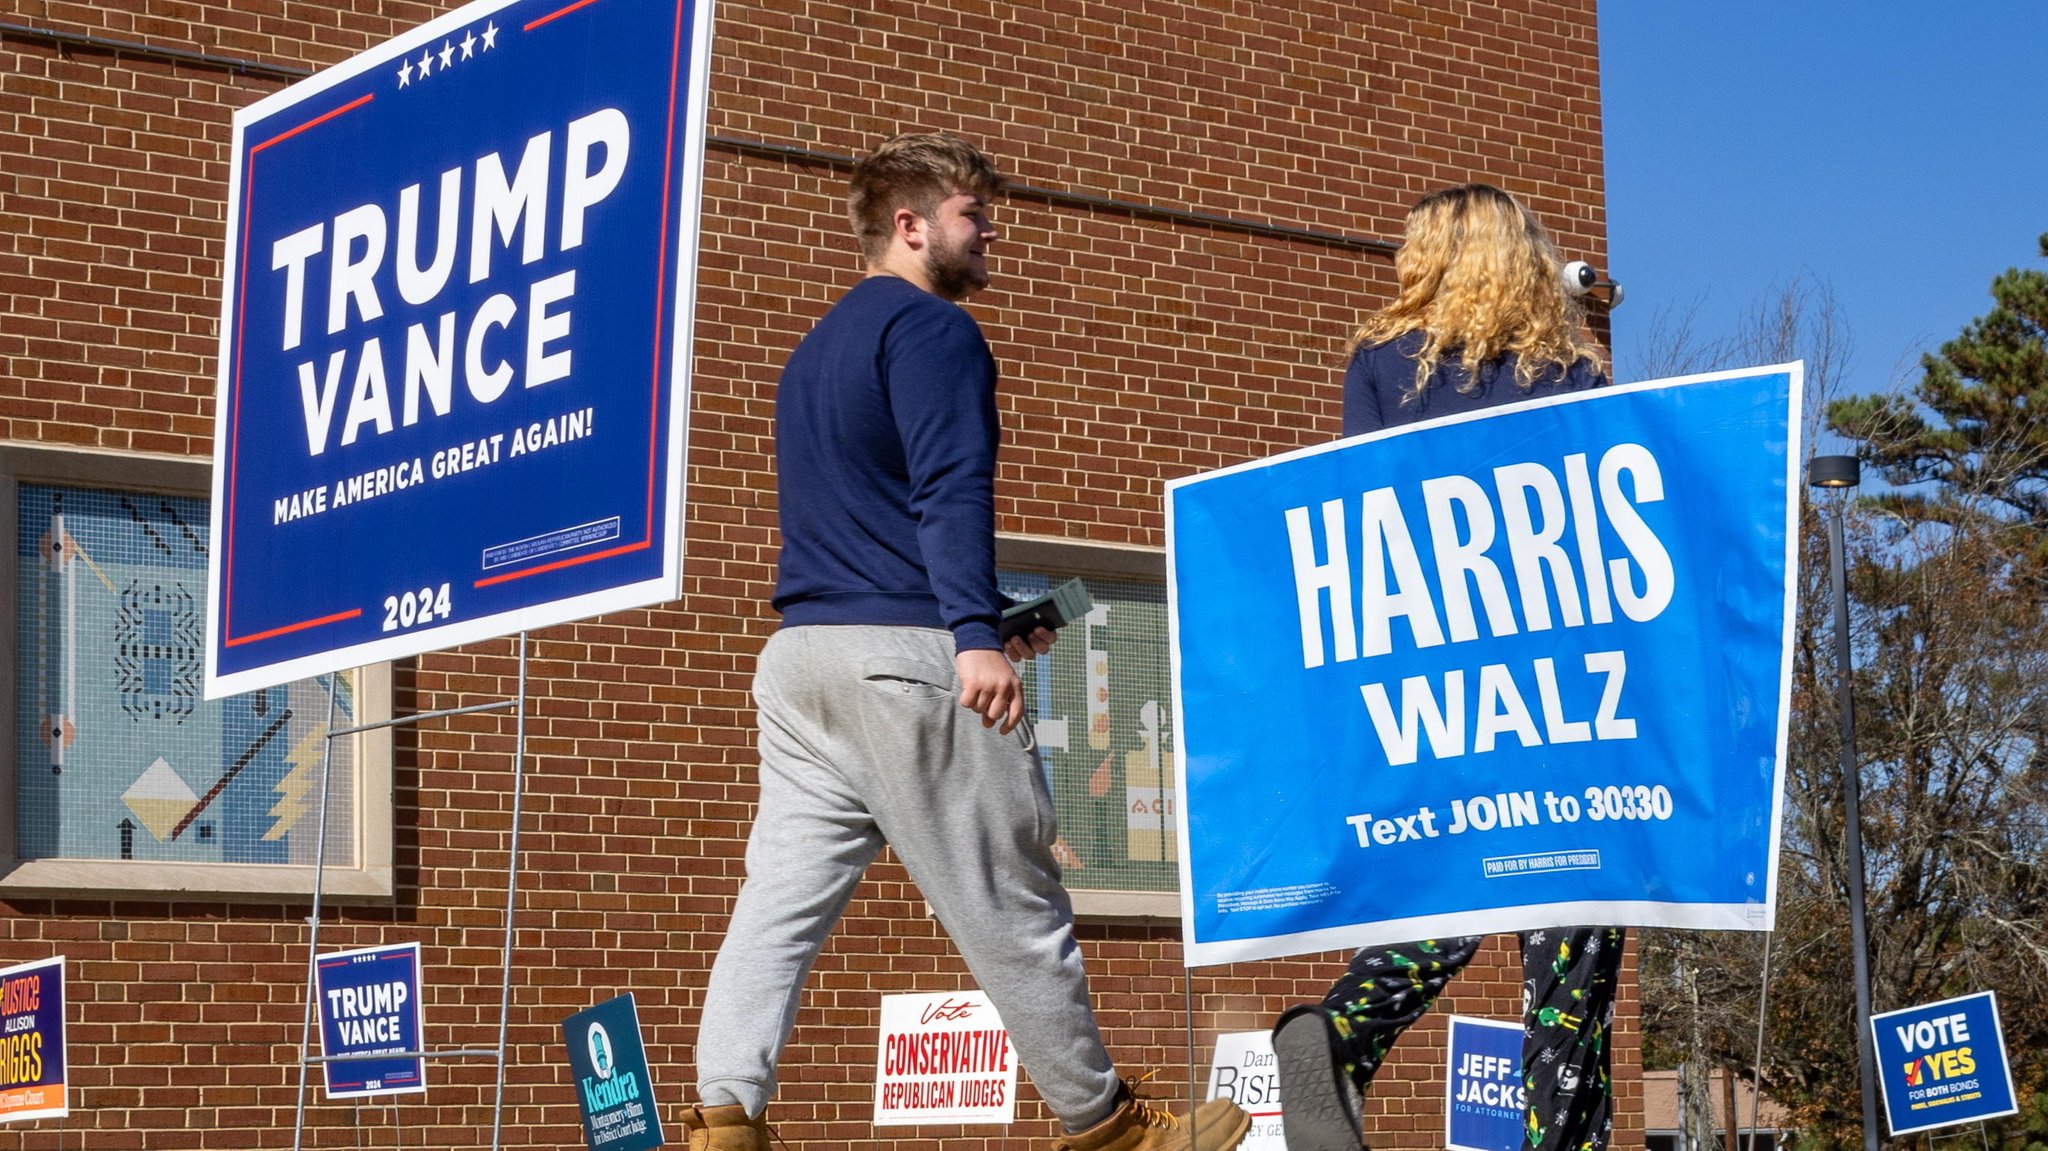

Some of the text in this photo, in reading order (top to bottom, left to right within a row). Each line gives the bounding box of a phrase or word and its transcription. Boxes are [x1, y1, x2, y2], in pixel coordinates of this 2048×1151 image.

[272, 108, 630, 351] TRUMP
[298, 269, 577, 456] VANCE
[274, 407, 594, 525] MAKE AMERICA GREAT AGAIN!
[1284, 442, 1675, 668] HARRIS
[382, 583, 451, 632] 2024
[1360, 650, 1638, 766] WALZ
[1346, 784, 1674, 848] Text JOIN to 30330
[1486, 853, 1598, 873] PAID FOR BY HARRIS FOR PRESIDENT
[2, 975, 40, 1016] JUSTICE
[327, 981, 408, 1019] TRUMP
[920, 998, 982, 1025] Vote
[5, 1015, 35, 1033] ALLISON
[338, 1016, 401, 1046] VANCE
[1896, 1012, 1970, 1053] VOTE
[0, 1031, 42, 1086] RIGGS
[885, 1029, 1009, 1076] CONSERVATIVE
[1243, 1050, 1274, 1068] Dan
[1457, 1053, 1512, 1081] JEFF
[1924, 1047, 1976, 1081] YES
[582, 1065, 640, 1114] Kendra
[882, 1079, 1006, 1110] REPUBLICAN JUDGES
[1455, 1079, 1525, 1110] JACKS
[1908, 1079, 1979, 1100] FOR BOTH BONDS
[1455, 1103, 1521, 1120] FOR ATTORNEY
